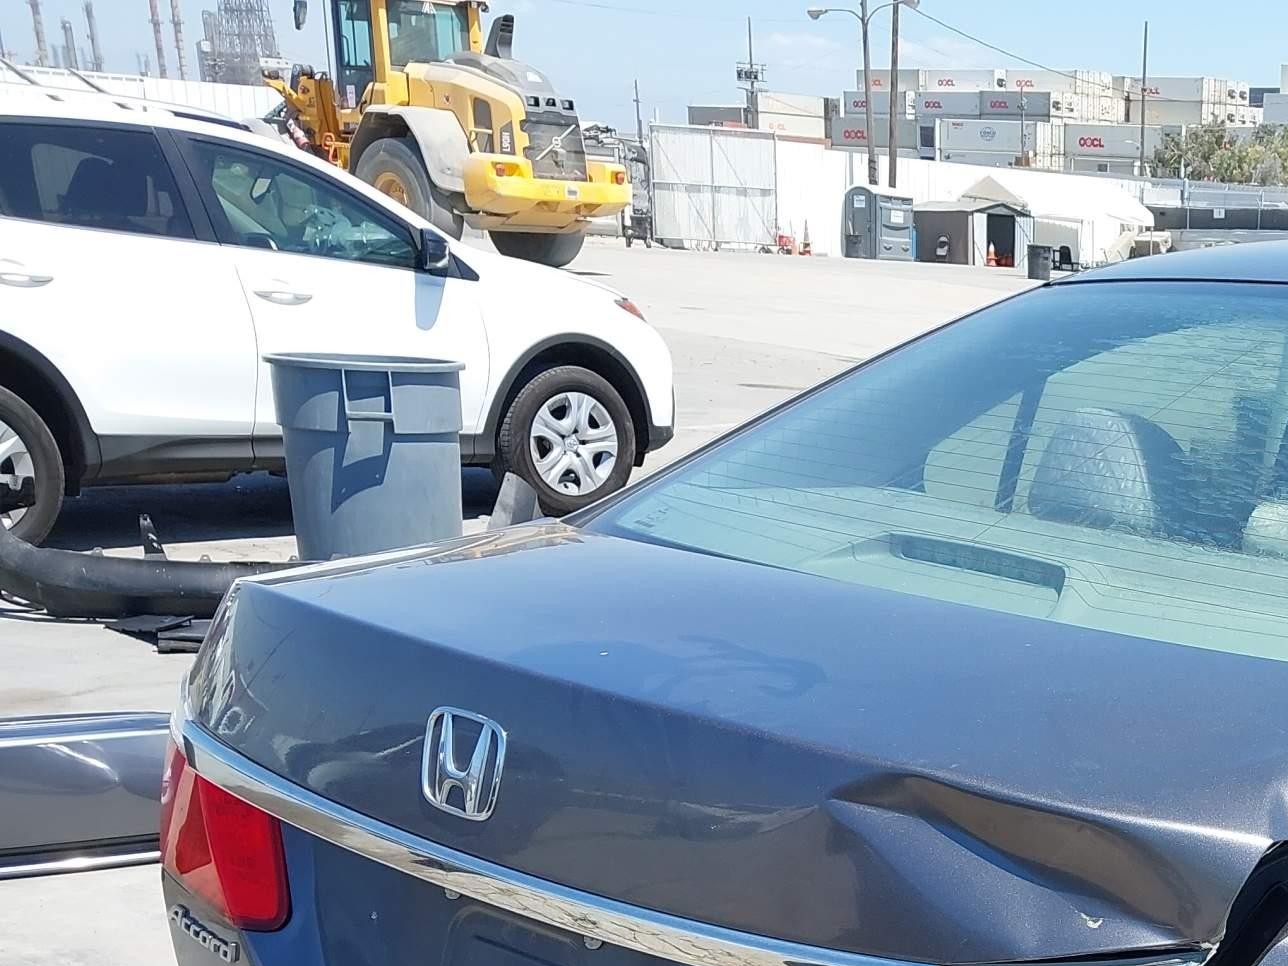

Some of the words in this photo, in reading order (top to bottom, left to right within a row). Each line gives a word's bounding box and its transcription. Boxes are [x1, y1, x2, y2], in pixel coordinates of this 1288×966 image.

[843, 129, 866, 140] OOCL
[1079, 137, 1104, 148] OOCL
[168, 904, 240, 962] Accord
